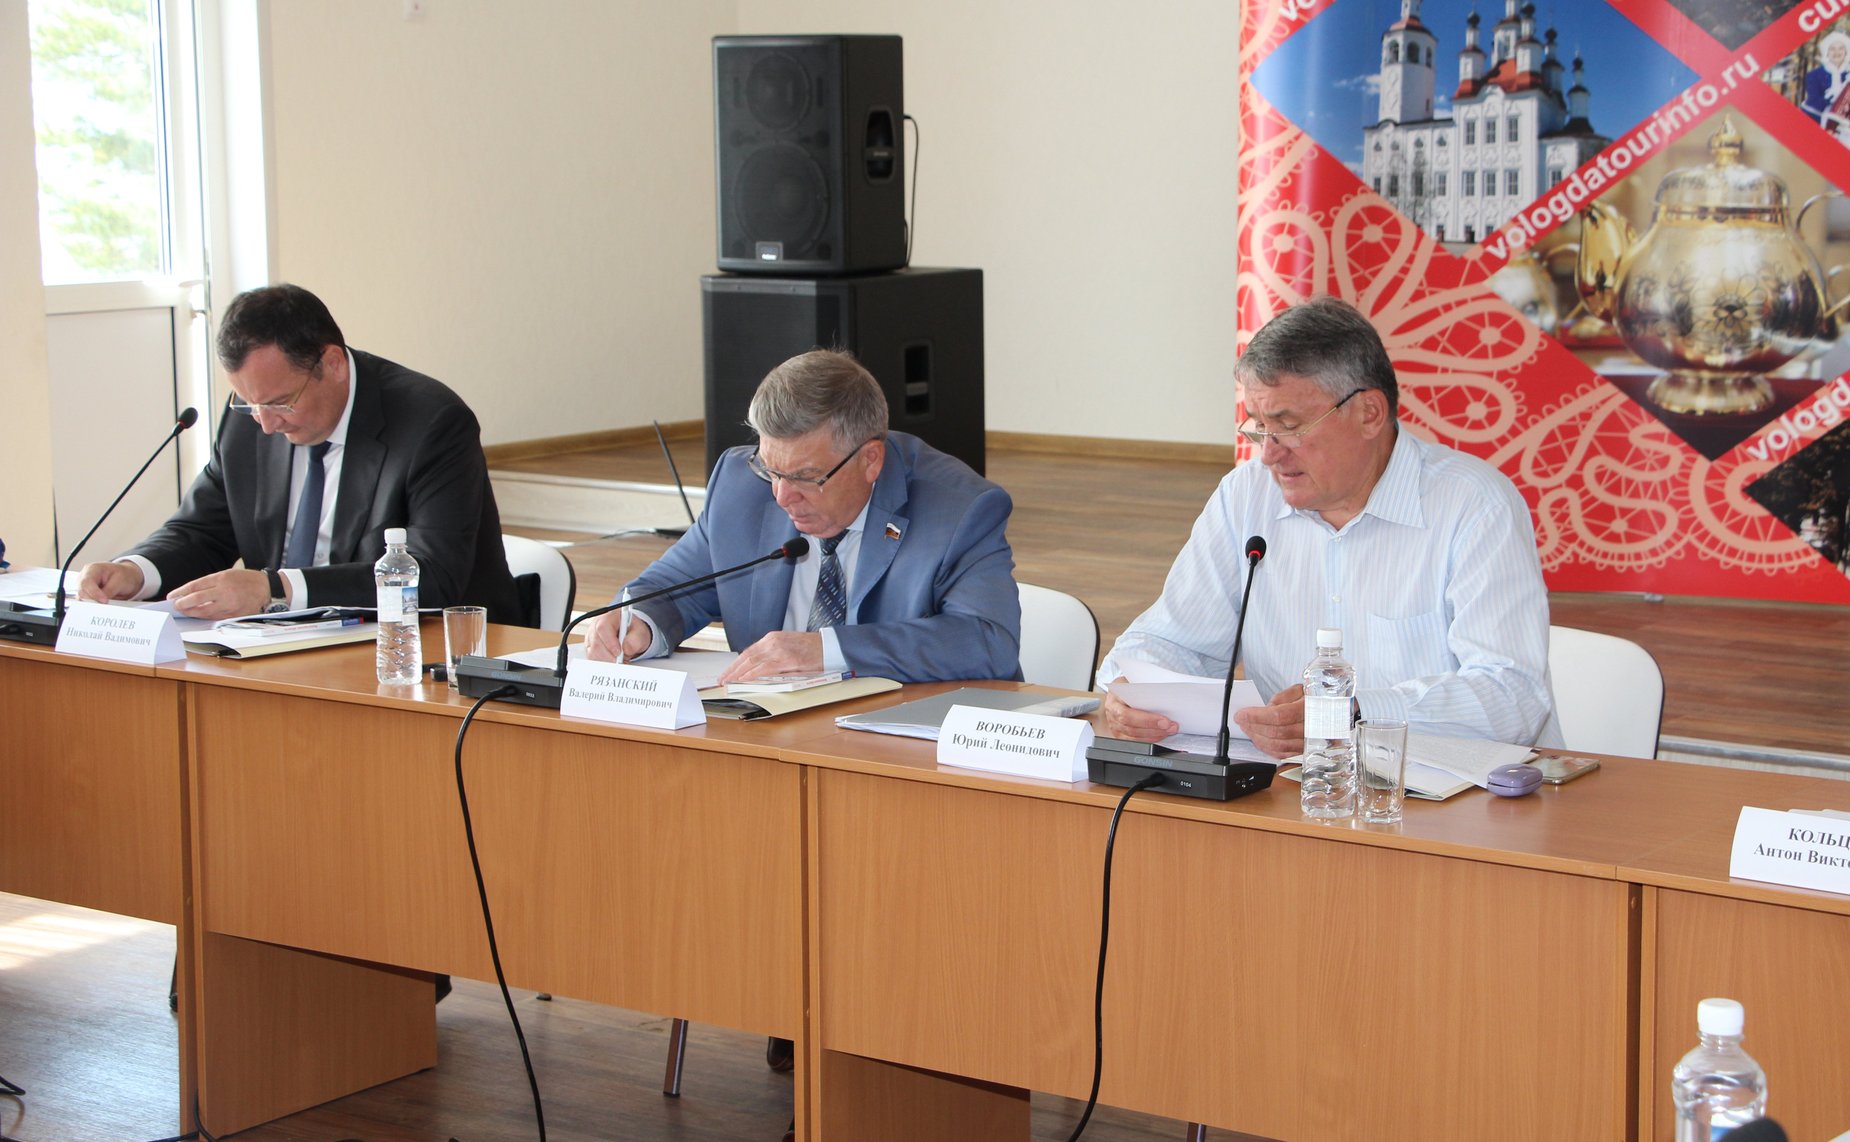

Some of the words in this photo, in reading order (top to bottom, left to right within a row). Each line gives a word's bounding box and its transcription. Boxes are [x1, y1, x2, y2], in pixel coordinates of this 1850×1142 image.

[1485, 53, 1760, 260] vologdatourinfo.ru
[1747, 377, 1850, 460] vologd
[90, 616, 136, 629] КОРОЛЕВ
[66, 627, 103, 641] Николай
[104, 632, 151, 646] Вадимович
[590, 674, 658, 692] РЯЗАНСКИЙ
[568, 688, 605, 701] Валерий
[607, 694, 673, 709] Владимирович
[975, 720, 1046, 740] ВОРОБЬЕВ
[952, 733, 987, 749] Юрий
[989, 738, 1060, 759] Леонидович
[1134, 756, 1173, 769] GONSIN
[1788, 828, 1850, 850] КОЛЬЦ
[1753, 843, 1802, 861] Антон
[1807, 850, 1850, 868] Викт
